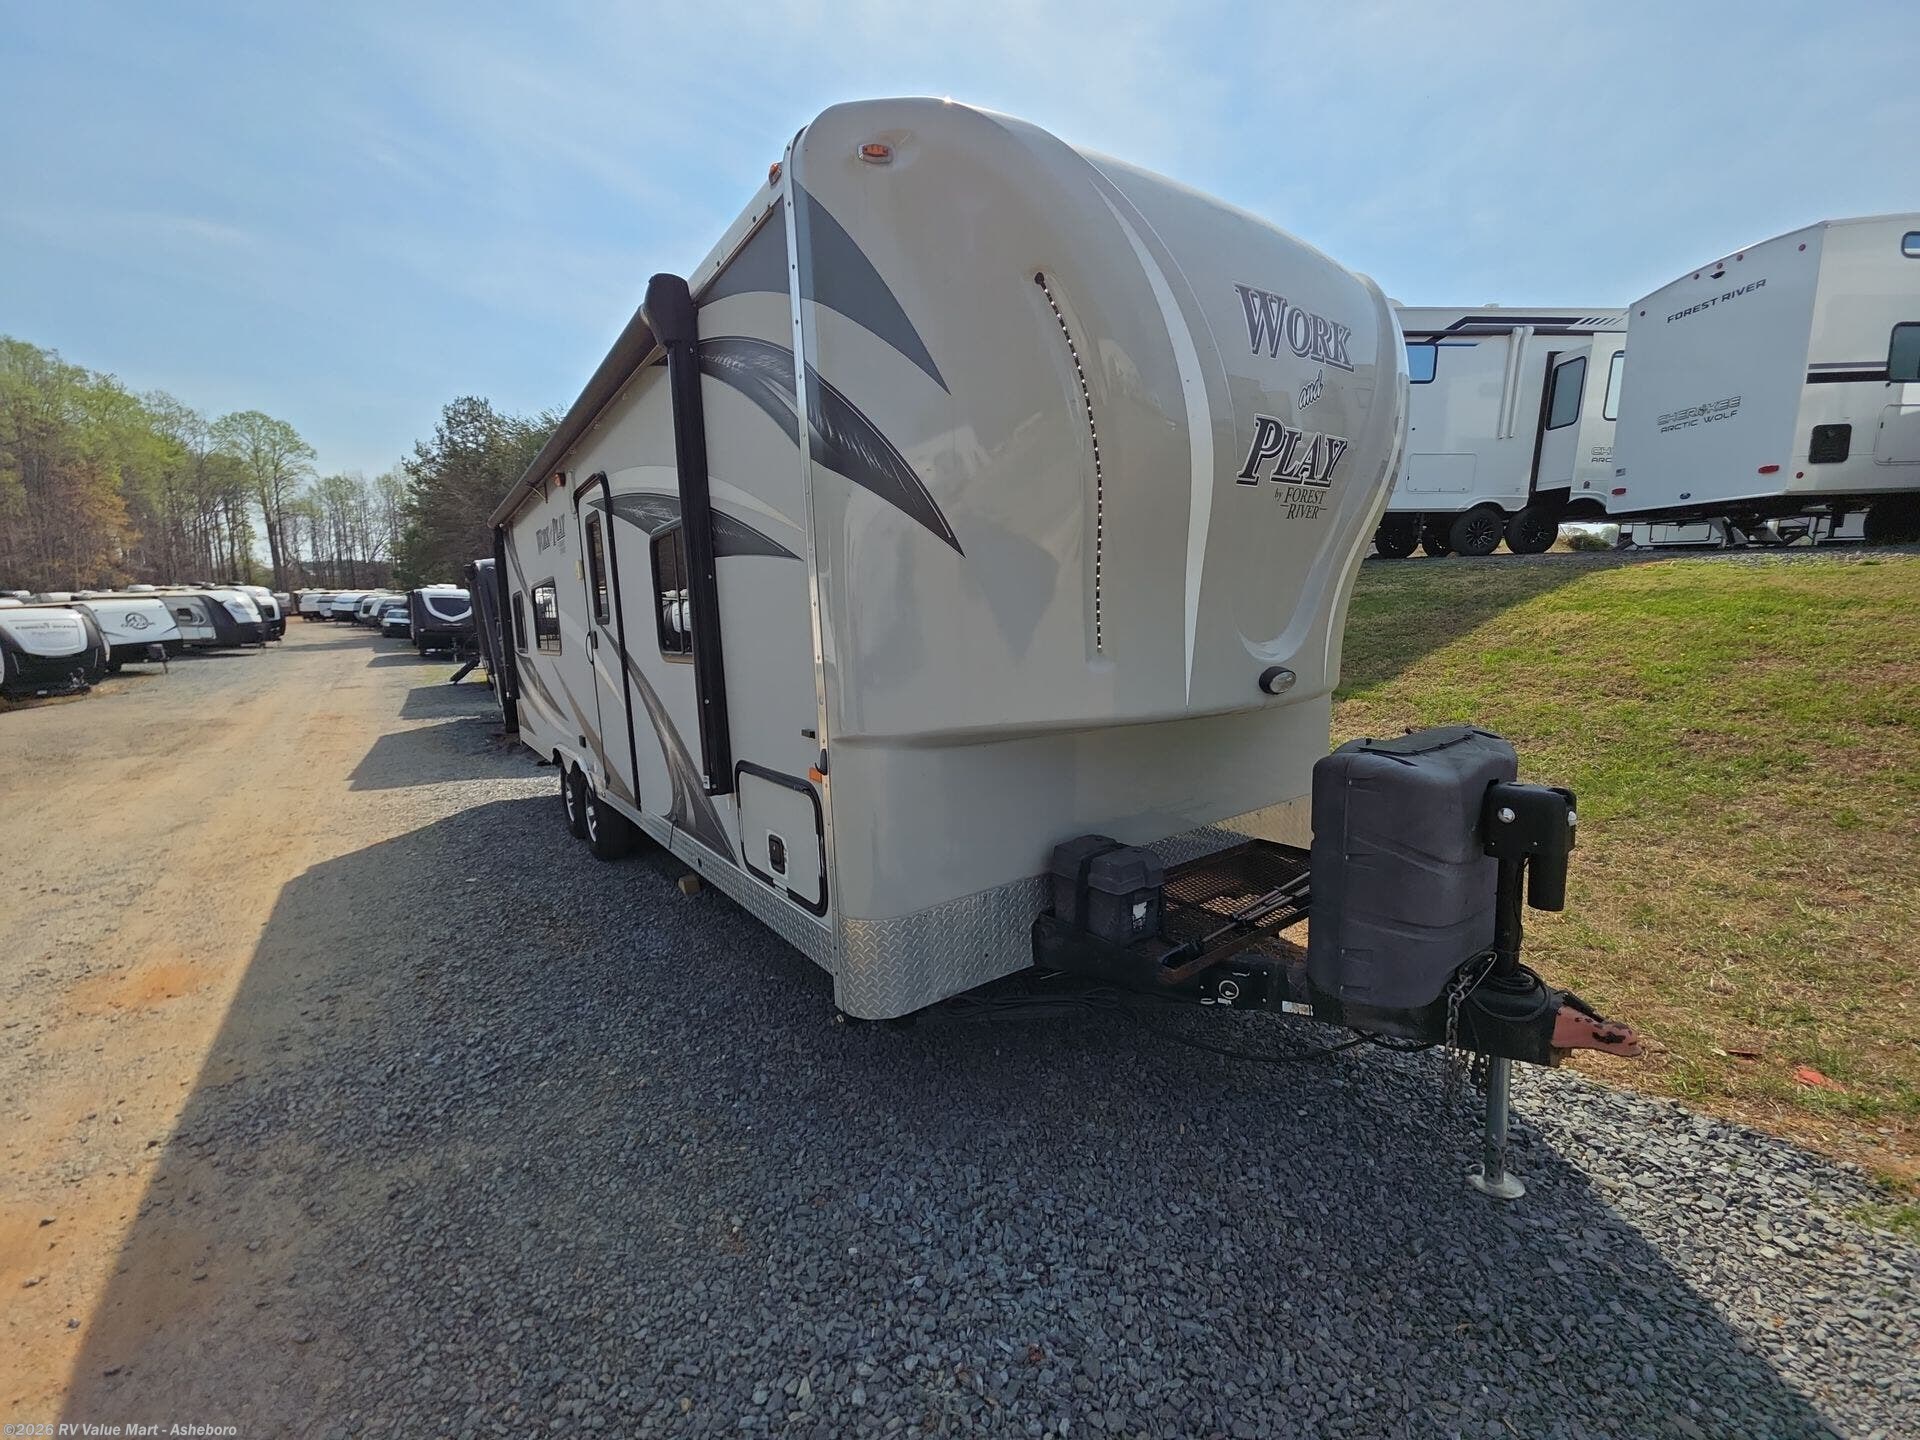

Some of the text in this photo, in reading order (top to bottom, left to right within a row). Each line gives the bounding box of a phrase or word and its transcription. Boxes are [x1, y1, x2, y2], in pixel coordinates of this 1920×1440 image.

[1667, 279, 1766, 323] FOREST RIVER
[1234, 282, 1354, 372] WORK
[1298, 369, 1325, 410] and
[1657, 396, 1741, 425] CHEROKEE
[1660, 409, 1738, 434] ARCTIC WOLF
[1236, 414, 1348, 488] PLAY
[1591, 446, 1612, 456] CH
[1284, 487, 1326, 505] FOREST
[1286, 503, 1320, 520] RIVER
